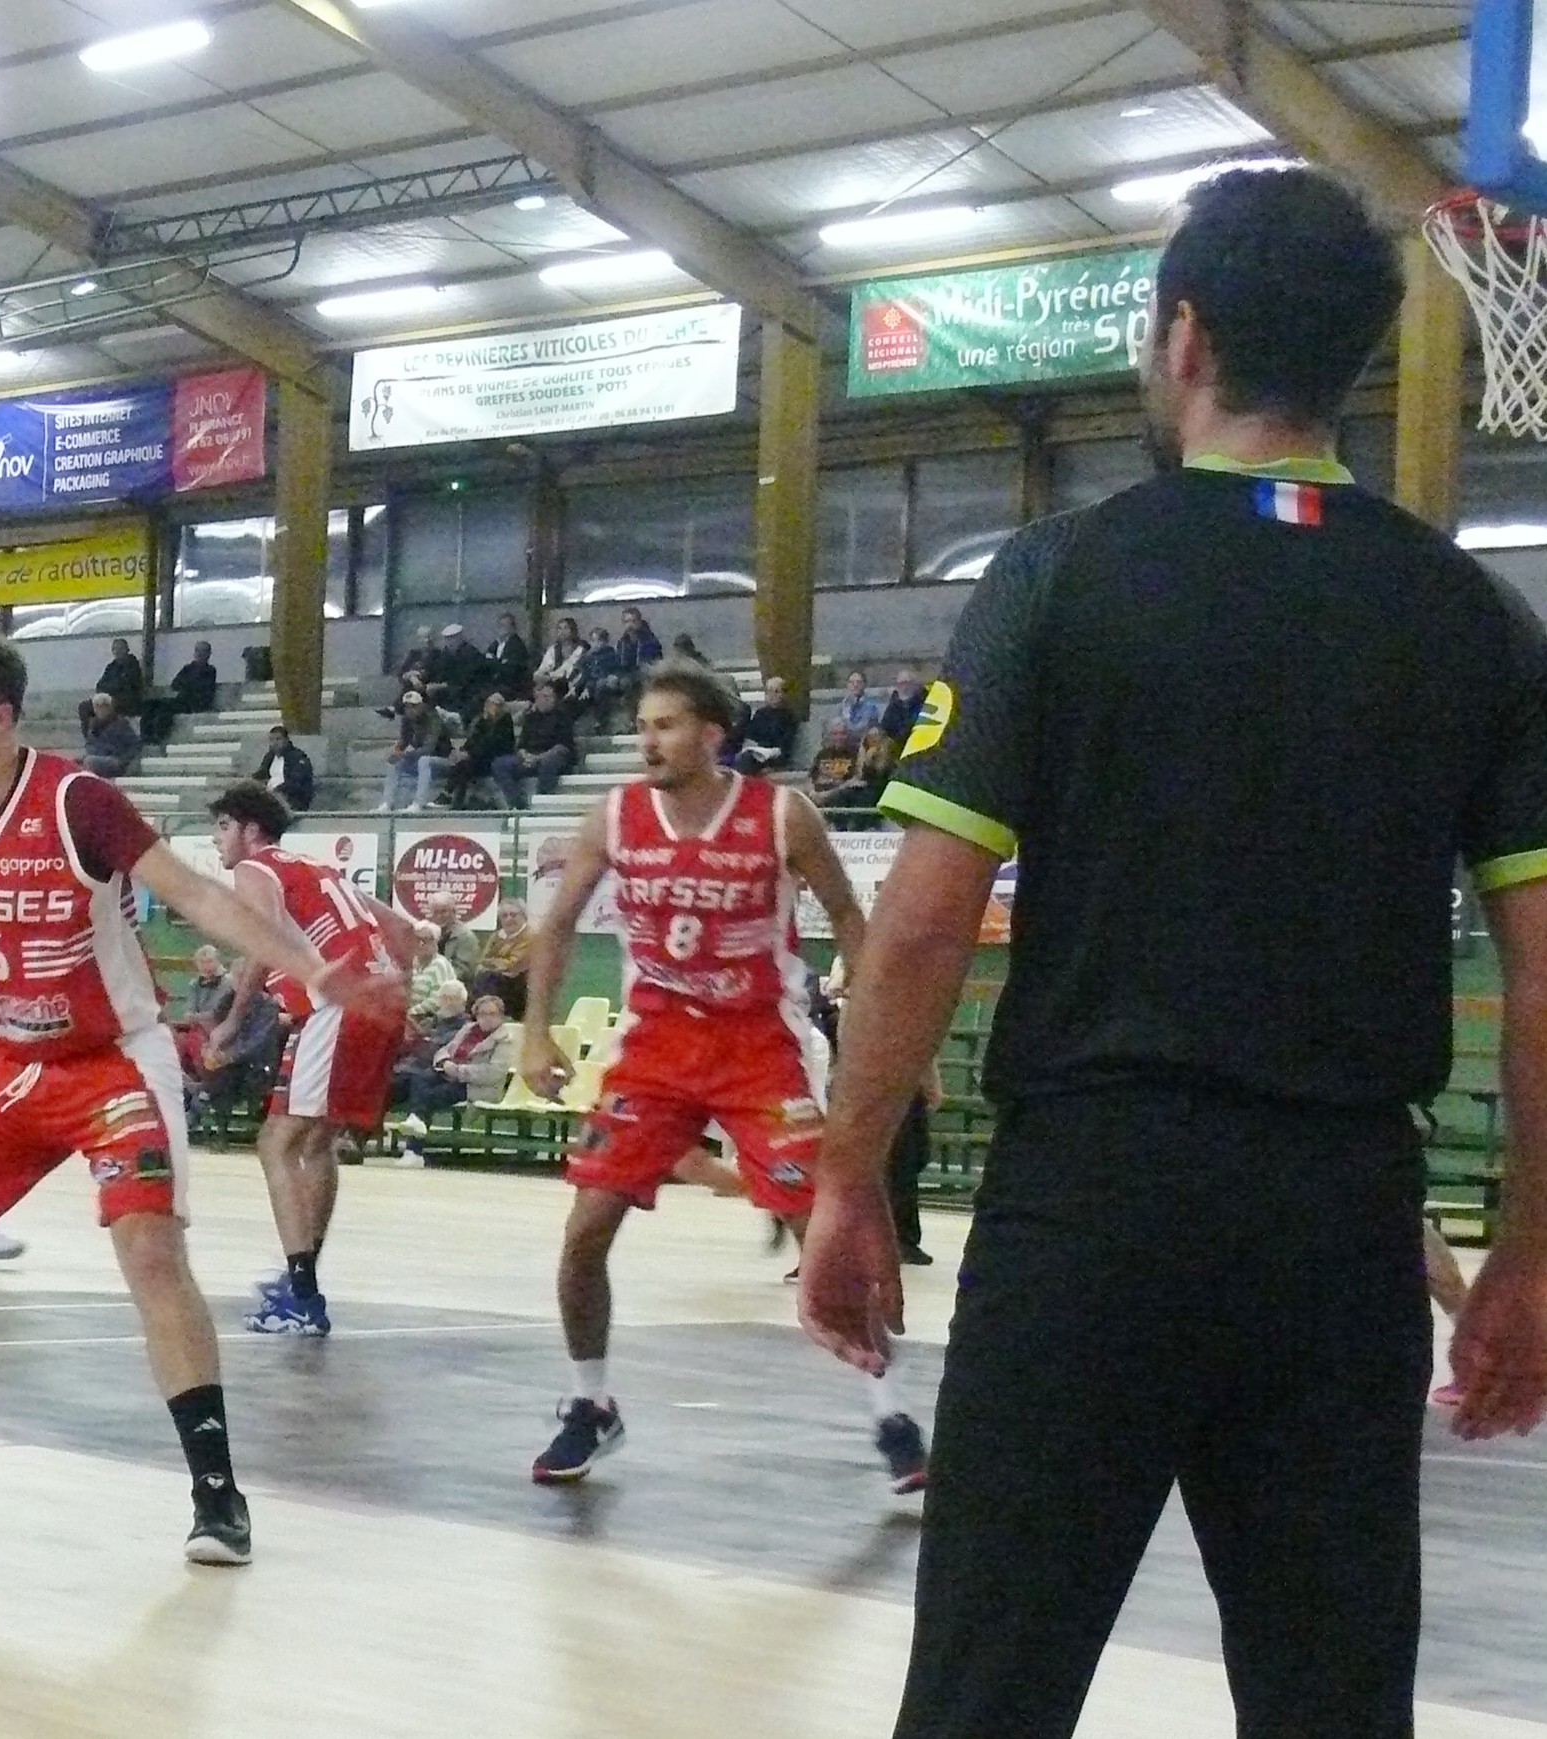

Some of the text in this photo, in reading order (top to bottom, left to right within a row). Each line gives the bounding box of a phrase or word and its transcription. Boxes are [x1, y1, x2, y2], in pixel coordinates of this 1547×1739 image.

[932, 266, 1153, 326] Midi-Pyrénée
[1062, 318, 1091, 334] très
[534, 331, 617, 360] VITICOLES
[623, 327, 648, 347] DU
[867, 333, 919, 347] CONSEIL
[957, 335, 1076, 368] une région
[458, 383, 474, 395] DE
[598, 364, 633, 379] TOUS
[475, 391, 526, 407] GREFFES
[529, 384, 585, 402] SOUDÉES
[596, 379, 629, 394] POTS
[55, 406, 133, 430] SITES INTERNET
[188, 391, 233, 418] JNOV
[55, 428, 122, 451] E-COMMERCE
[54, 451, 103, 472] CREATION
[104, 443, 164, 466] GRAPHIQUE
[53, 472, 110, 493] PACKAGING
[5, 563, 33, 585] de
[664, 913, 704, 961] 8
